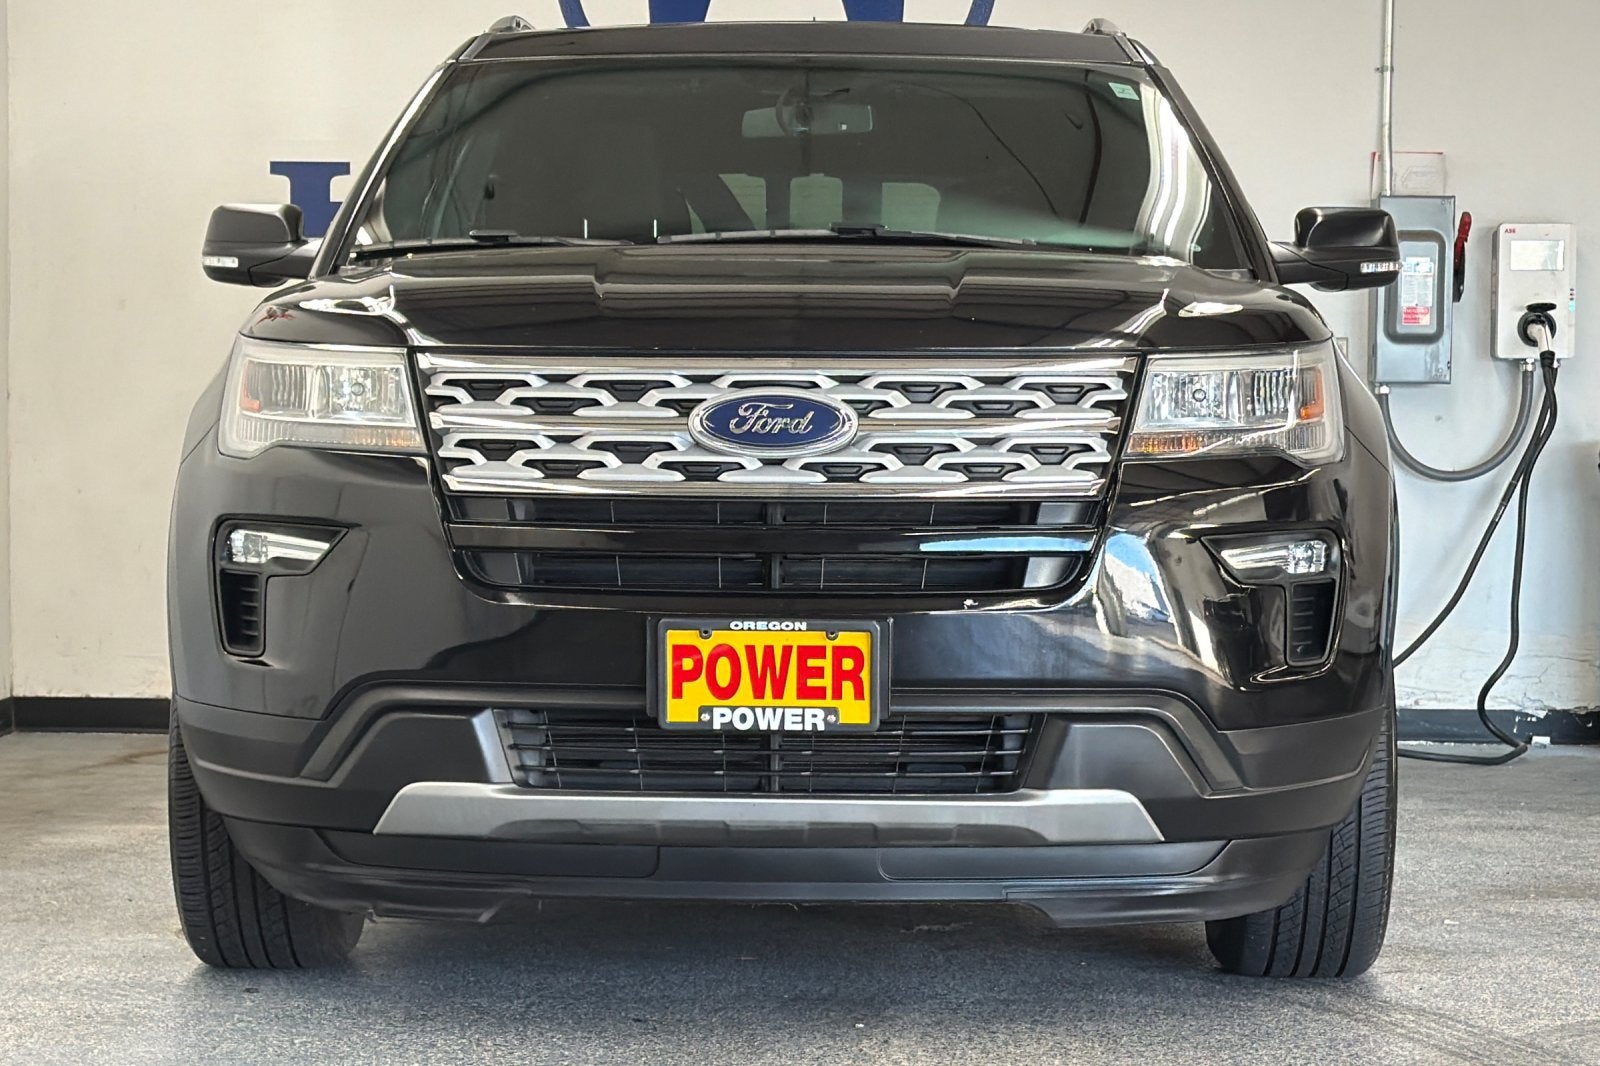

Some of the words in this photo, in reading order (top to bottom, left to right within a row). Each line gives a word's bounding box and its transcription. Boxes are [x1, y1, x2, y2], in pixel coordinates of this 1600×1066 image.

[729, 402, 815, 434] Ford
[729, 621, 807, 631] OREGON
[671, 643, 865, 700] POWER
[712, 707, 825, 731] POWER
